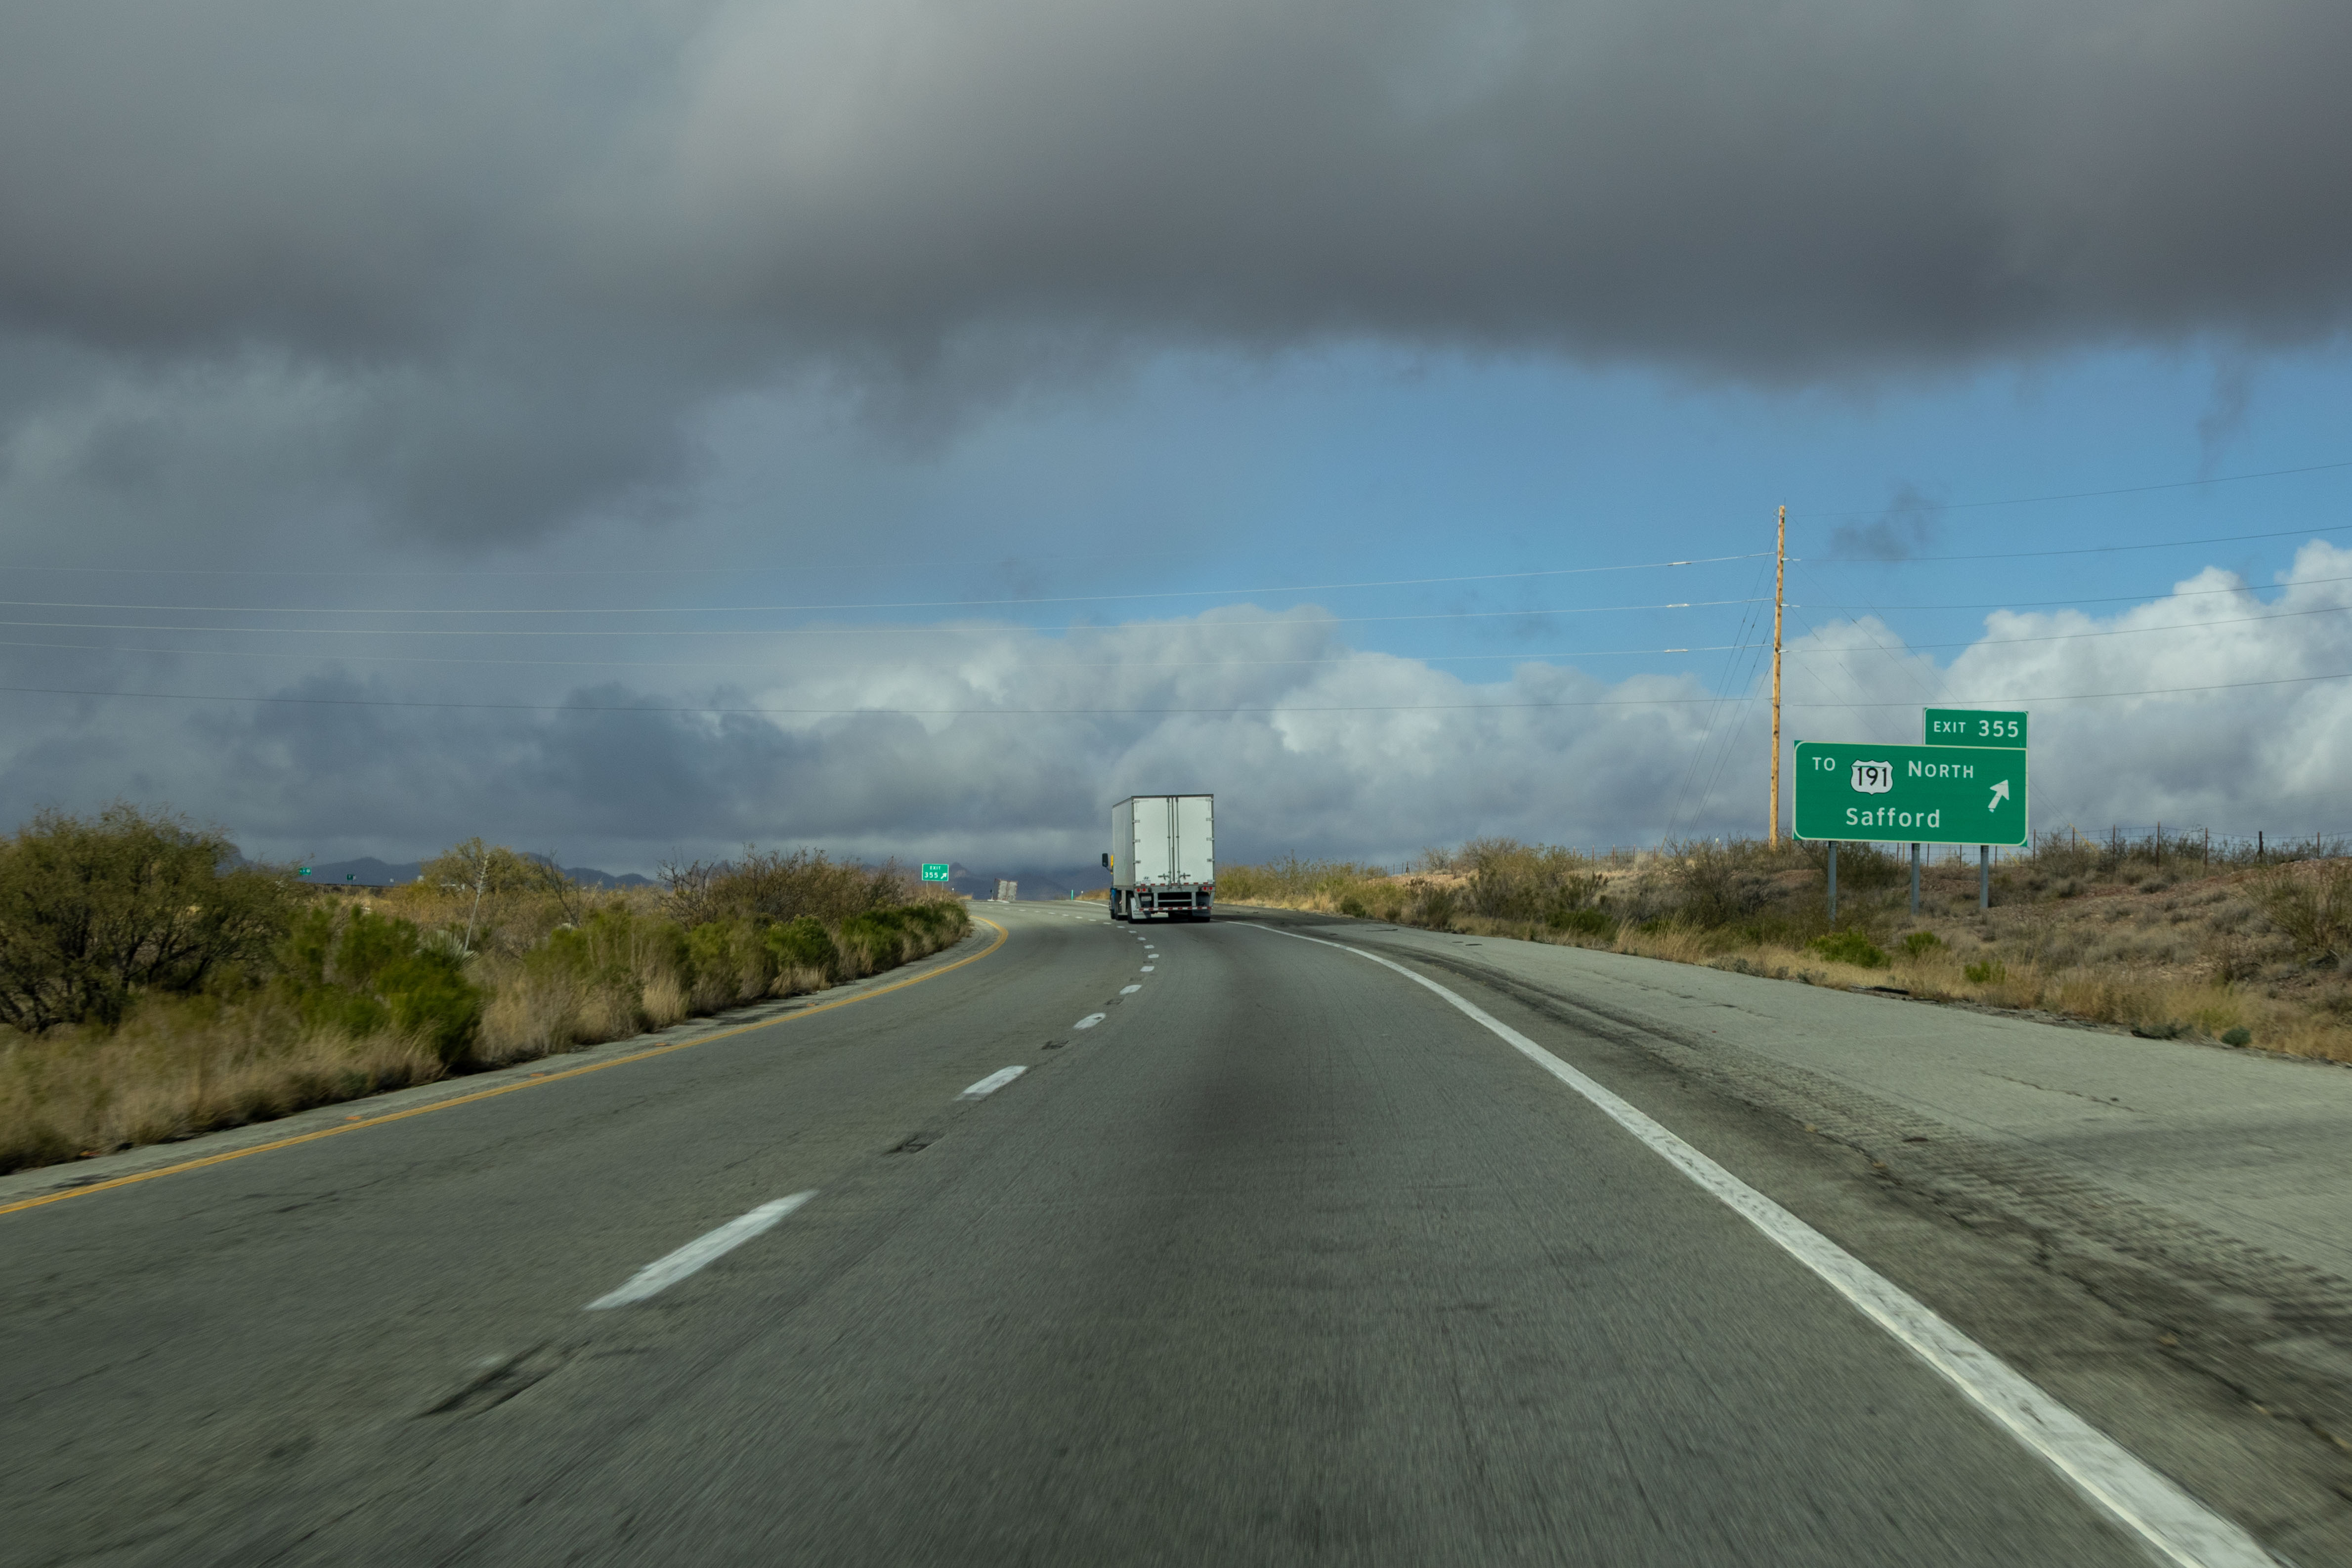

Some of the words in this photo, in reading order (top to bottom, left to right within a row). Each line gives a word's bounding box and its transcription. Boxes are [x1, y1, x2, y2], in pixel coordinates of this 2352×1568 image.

[1933, 721, 1966, 733] EXIT
[1978, 720, 2019, 737] 355
[1812, 757, 1836, 771] TO
[1857, 766, 1887, 787] 191
[1908, 761, 1974, 778] NORTH
[1846, 807, 1940, 828] Safford
